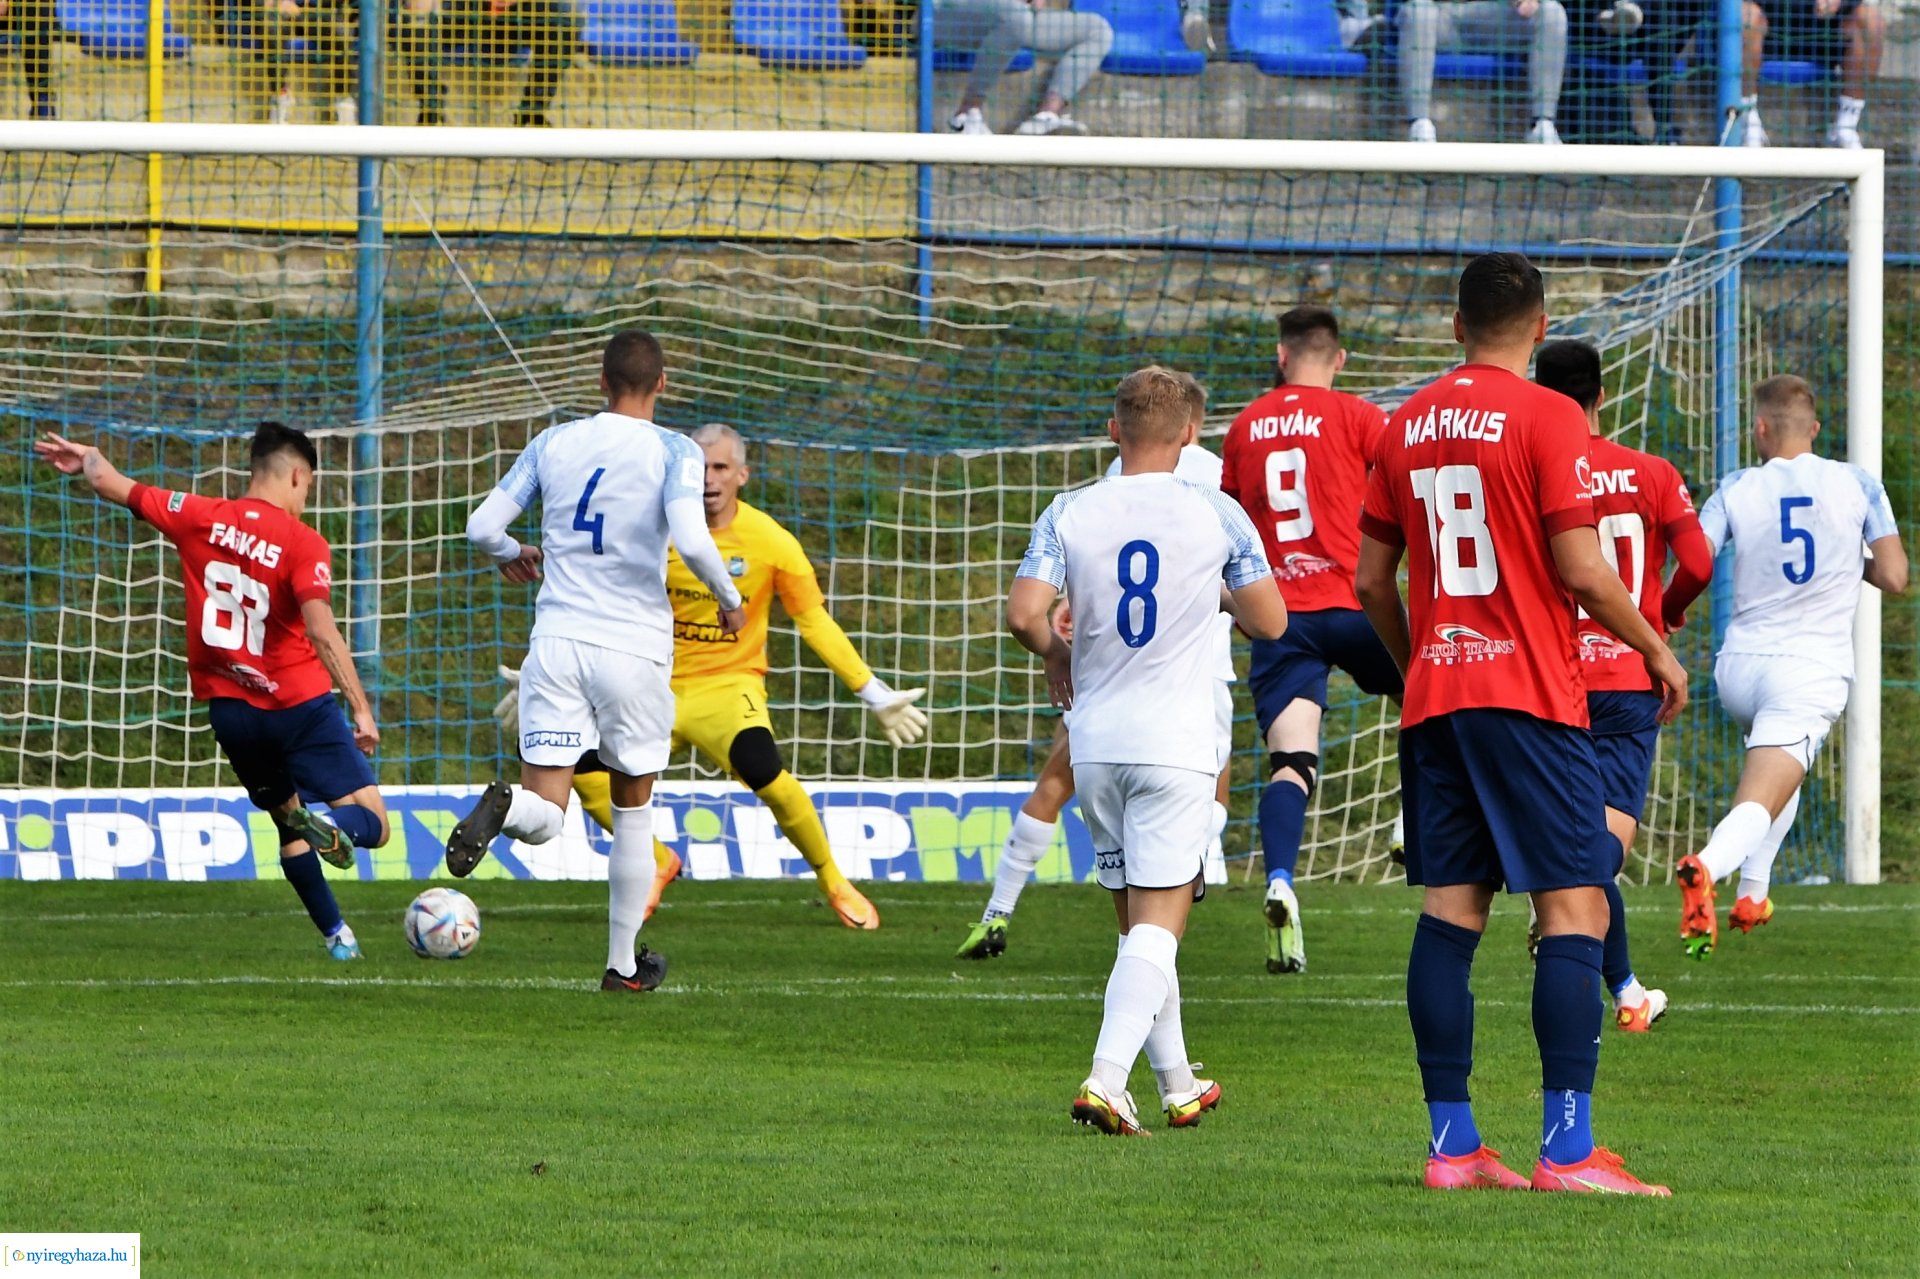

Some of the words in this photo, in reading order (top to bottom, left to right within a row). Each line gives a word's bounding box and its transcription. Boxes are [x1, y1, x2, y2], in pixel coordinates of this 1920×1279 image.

[1250, 408, 1323, 442] NOVÁK
[1404, 404, 1507, 449] MÁRKUS
[572, 467, 606, 555] 4
[1265, 447, 1314, 543] 9
[1591, 468, 1638, 497] OVIC
[1409, 464, 1499, 599] 18
[1578, 512, 1645, 620] 0
[1780, 496, 1816, 585] 5
[1117, 539, 1160, 649] 8
[1463, 639, 1516, 656] TRANS
